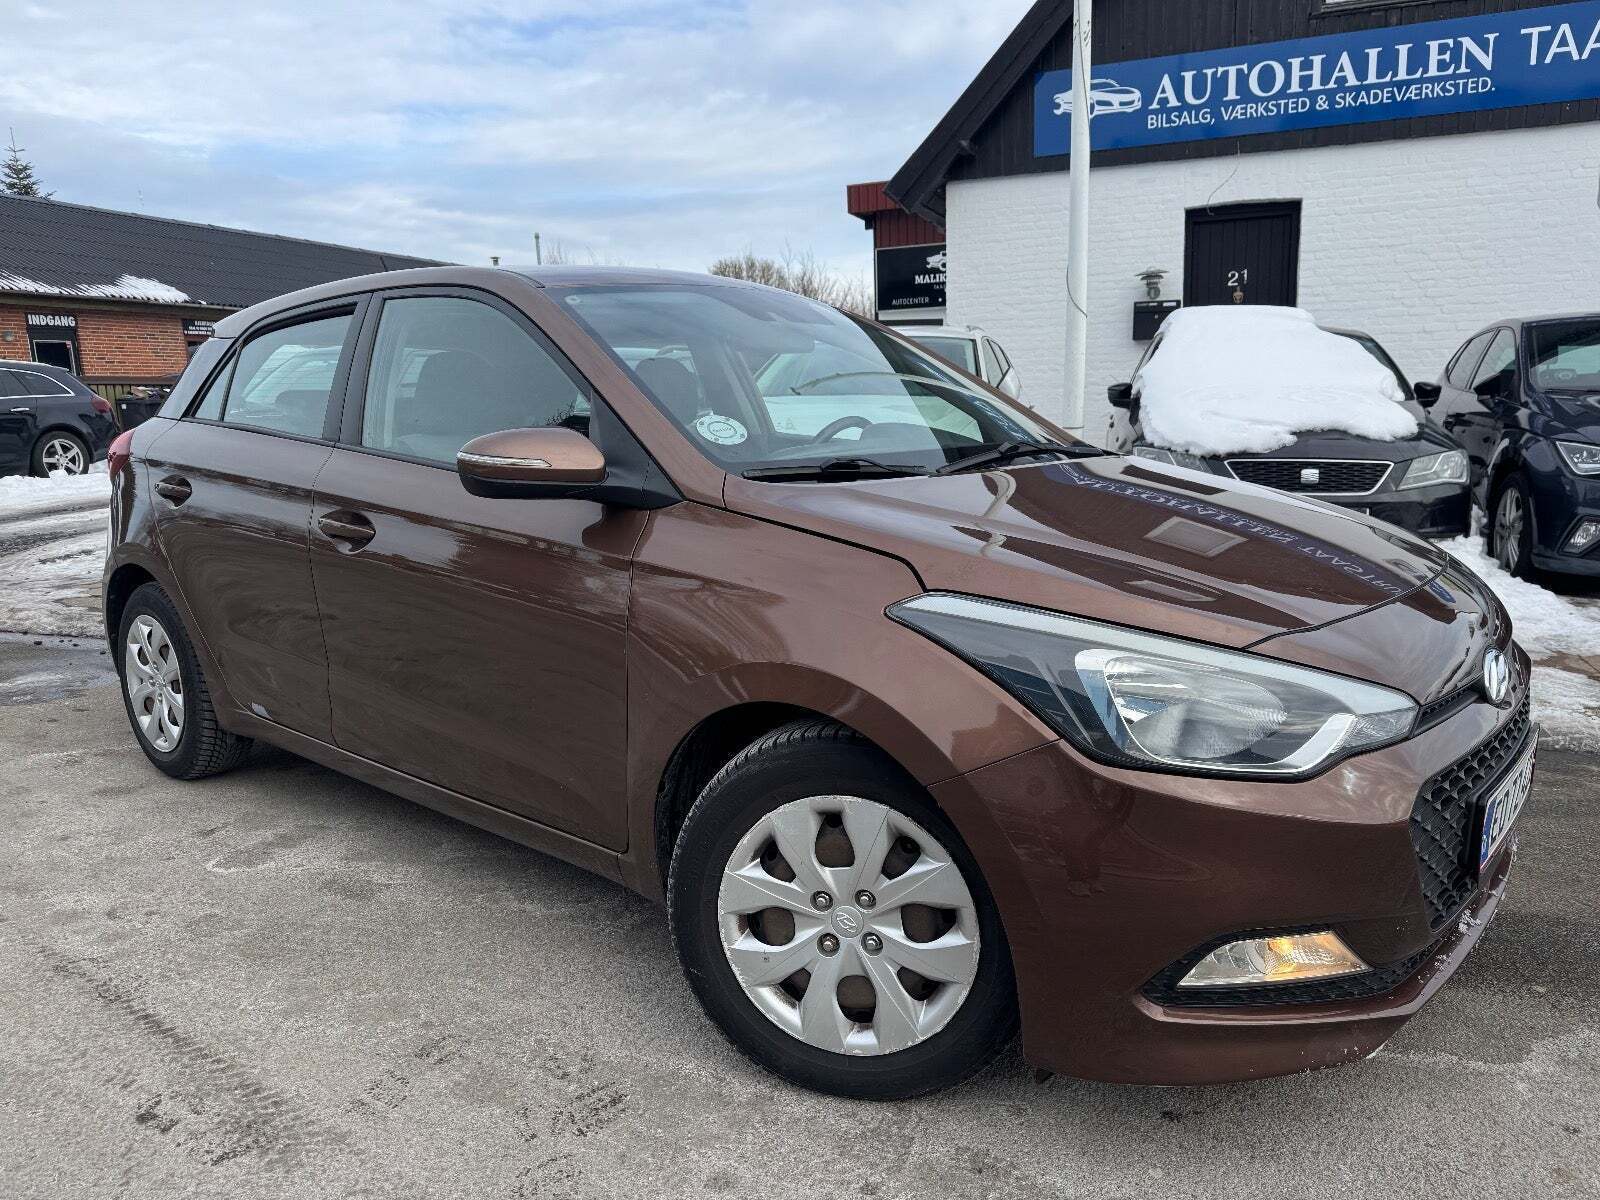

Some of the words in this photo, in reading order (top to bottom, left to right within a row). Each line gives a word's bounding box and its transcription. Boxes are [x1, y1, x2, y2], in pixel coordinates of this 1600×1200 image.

[1148, 32, 1499, 109] AUTOHALLEN
[1147, 108, 1216, 129] BILSALG,
[1221, 97, 1310, 121] VÆRKSTED
[1317, 95, 1330, 111] &
[1335, 77, 1496, 108] SKADEVÆRKSTED.
[1227, 268, 1248, 286] 21
[892, 297, 929, 305] AUTOCENTER
[28, 314, 76, 327] INDGANG
